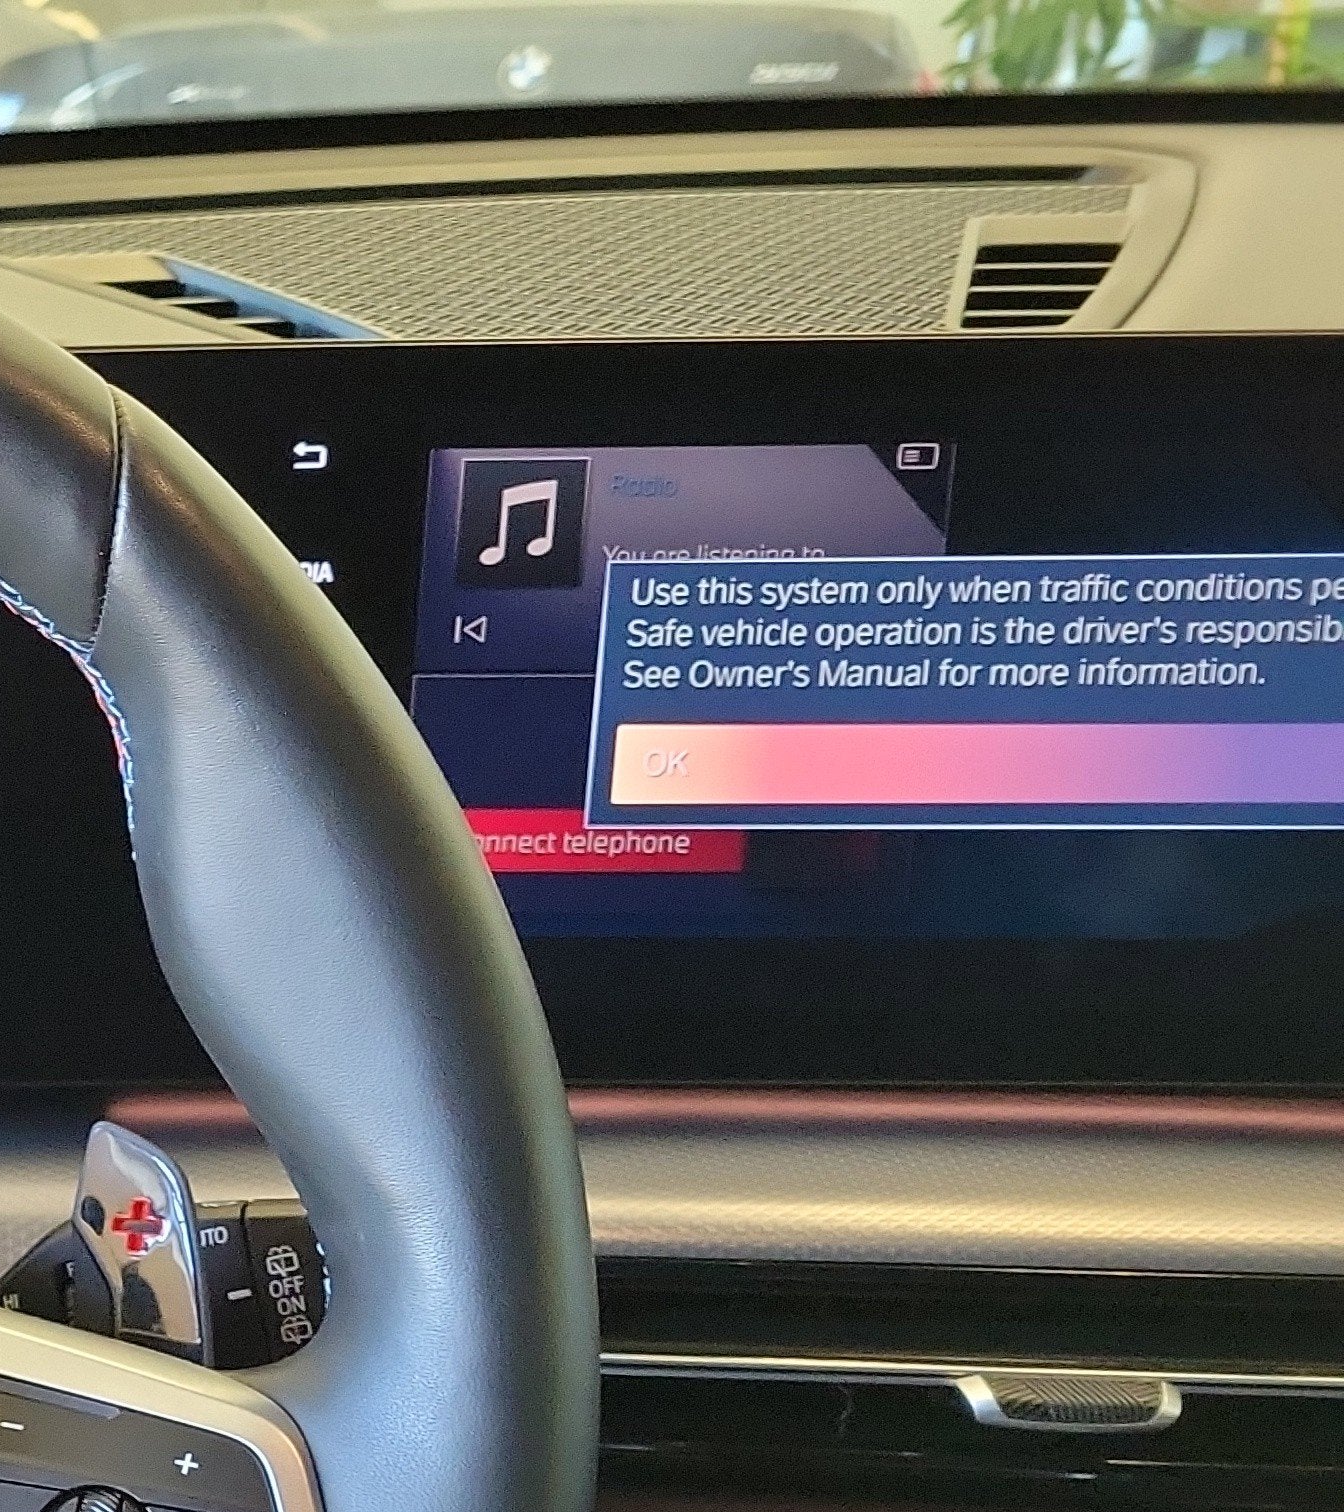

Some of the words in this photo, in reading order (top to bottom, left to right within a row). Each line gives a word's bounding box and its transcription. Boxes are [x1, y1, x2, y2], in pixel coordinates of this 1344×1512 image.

[631, 578, 689, 606] Use
[697, 577, 753, 605] this
[760, 578, 868, 610] system
[876, 576, 942, 609] only
[949, 576, 1031, 603] when
[1040, 574, 1128, 602] traffic
[1136, 572, 1303, 601] conditions
[626, 618, 693, 647] Safe
[701, 618, 807, 646] vehicle
[815, 617, 962, 651] operation
[971, 617, 996, 644] is
[1004, 617, 1055, 644] the
[1063, 616, 1177, 644] driver's
[1186, 615, 1344, 649] responsib
[623, 660, 681, 688] See
[688, 660, 810, 687] Owner's
[818, 659, 930, 687] Manual
[938, 658, 982, 686] for
[989, 664, 1069, 686] more
[1077, 658, 1265, 685] information.
[642, 751, 689, 777] OK
[562, 830, 691, 858] telephone
[269, 1275, 304, 1299] OFF
[277, 1296, 305, 1316] ON
